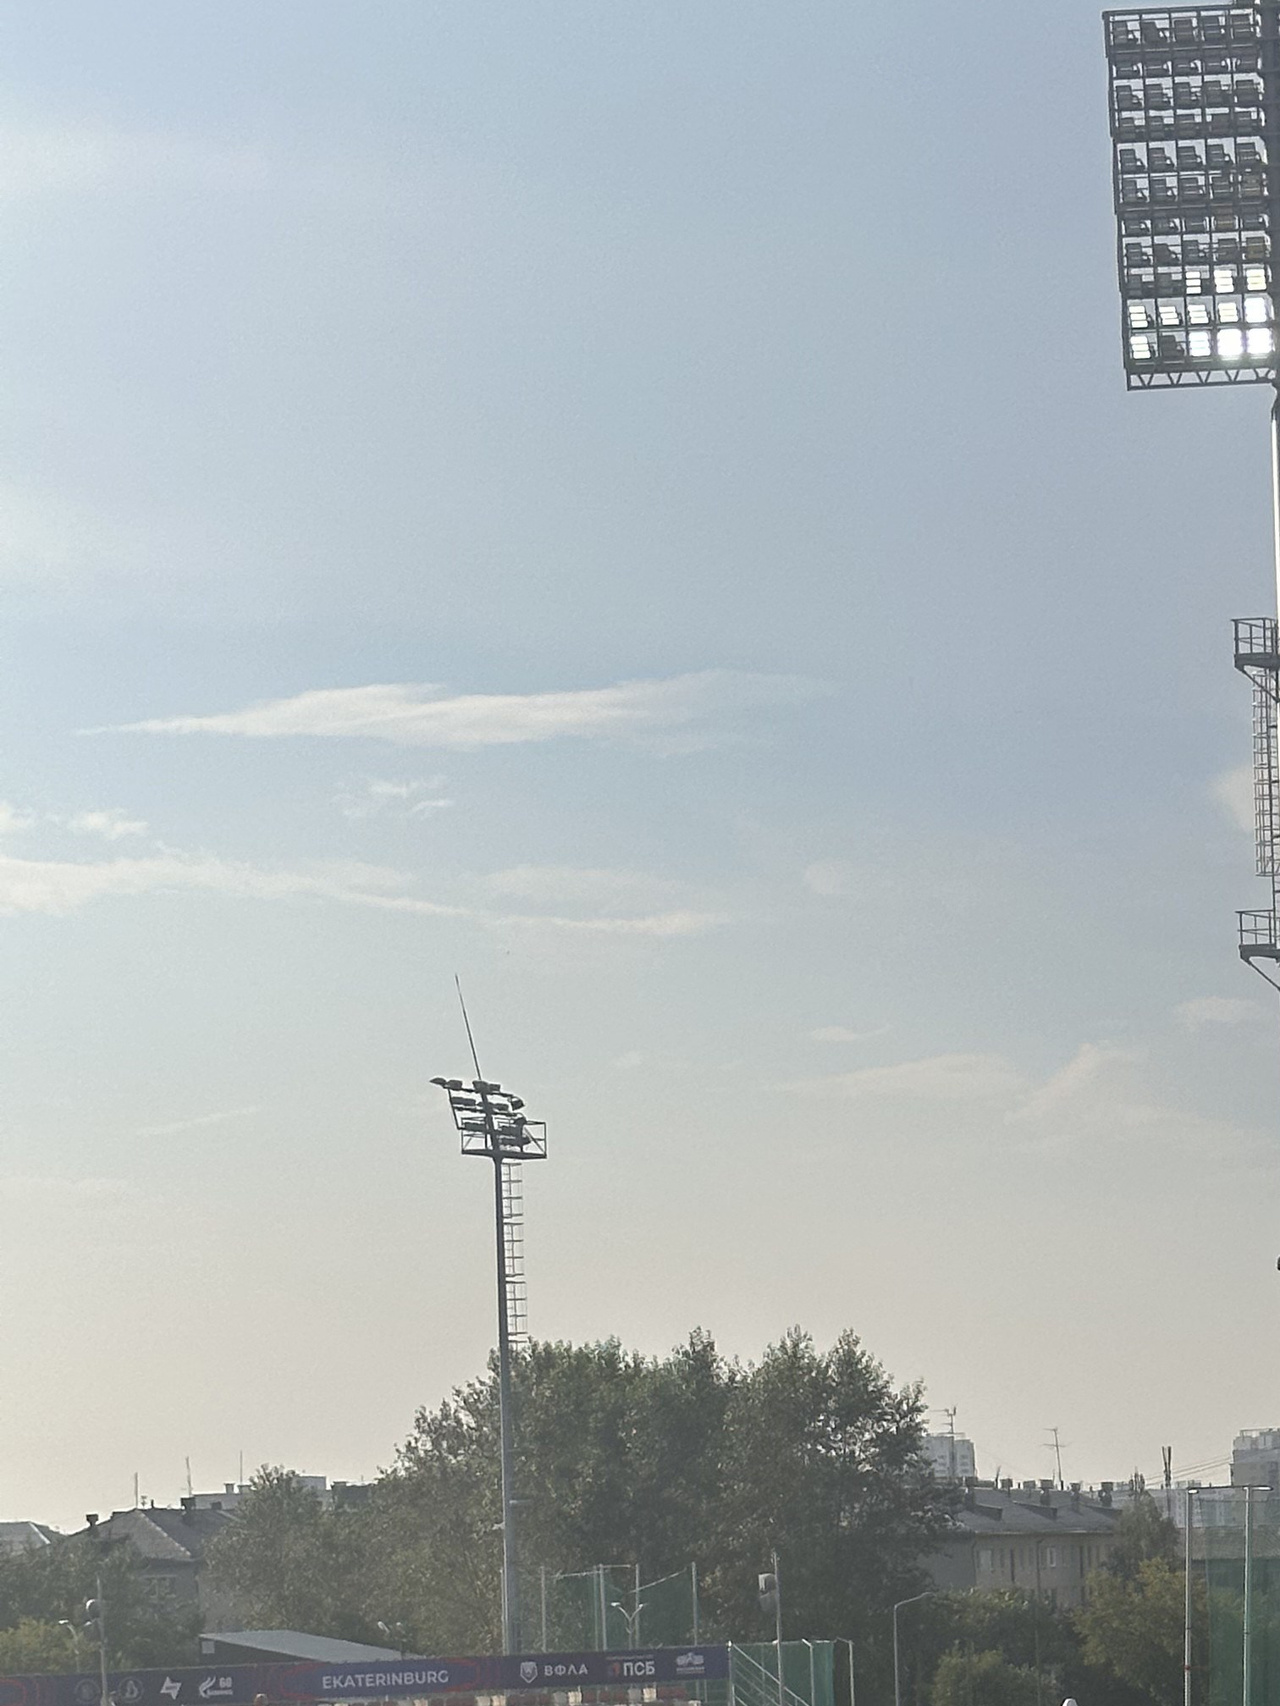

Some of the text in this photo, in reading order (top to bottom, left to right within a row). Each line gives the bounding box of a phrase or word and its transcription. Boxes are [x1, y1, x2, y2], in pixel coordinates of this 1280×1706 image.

[544, 1663, 588, 1677] ВФЛА
[623, 1660, 655, 1676] ПСБ
[322, 1670, 449, 1689] EKATERINBURG
